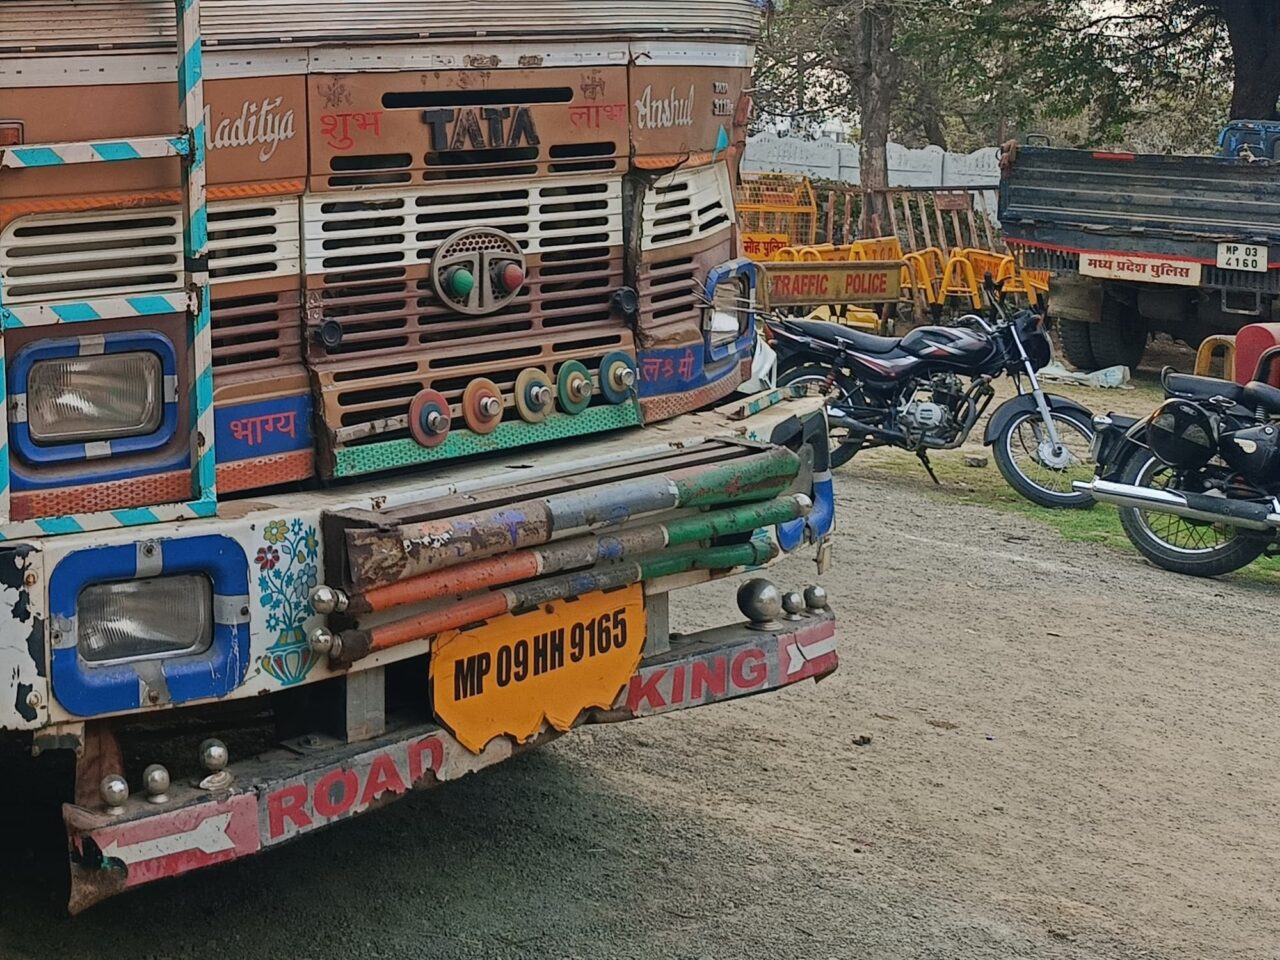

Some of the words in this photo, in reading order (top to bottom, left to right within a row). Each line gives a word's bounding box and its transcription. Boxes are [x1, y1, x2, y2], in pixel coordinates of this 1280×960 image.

[634, 83, 695, 129] Anshul
[320, 111, 384, 150] शुभ
[422, 105, 541, 151] TATA
[1088, 258, 1112, 270] मध्य
[1116, 258, 1147, 274] प्रदेश
[1151, 262, 1189, 278] पुलिस
[1226, 245, 1238, 254] MP
[1245, 246, 1257, 256] 03
[1226, 257, 1257, 268] 4160
[773, 274, 829, 296] TRAFFIC
[844, 272, 888, 294] POLICE
[230, 411, 296, 445] भाग्य
[454, 652, 491, 701] MP
[497, 640, 529, 687] 09
[533, 628, 565, 676] HH
[570, 608, 627, 662] 9165
[267, 737, 444, 838] ROAD
[625, 647, 767, 711] KING
